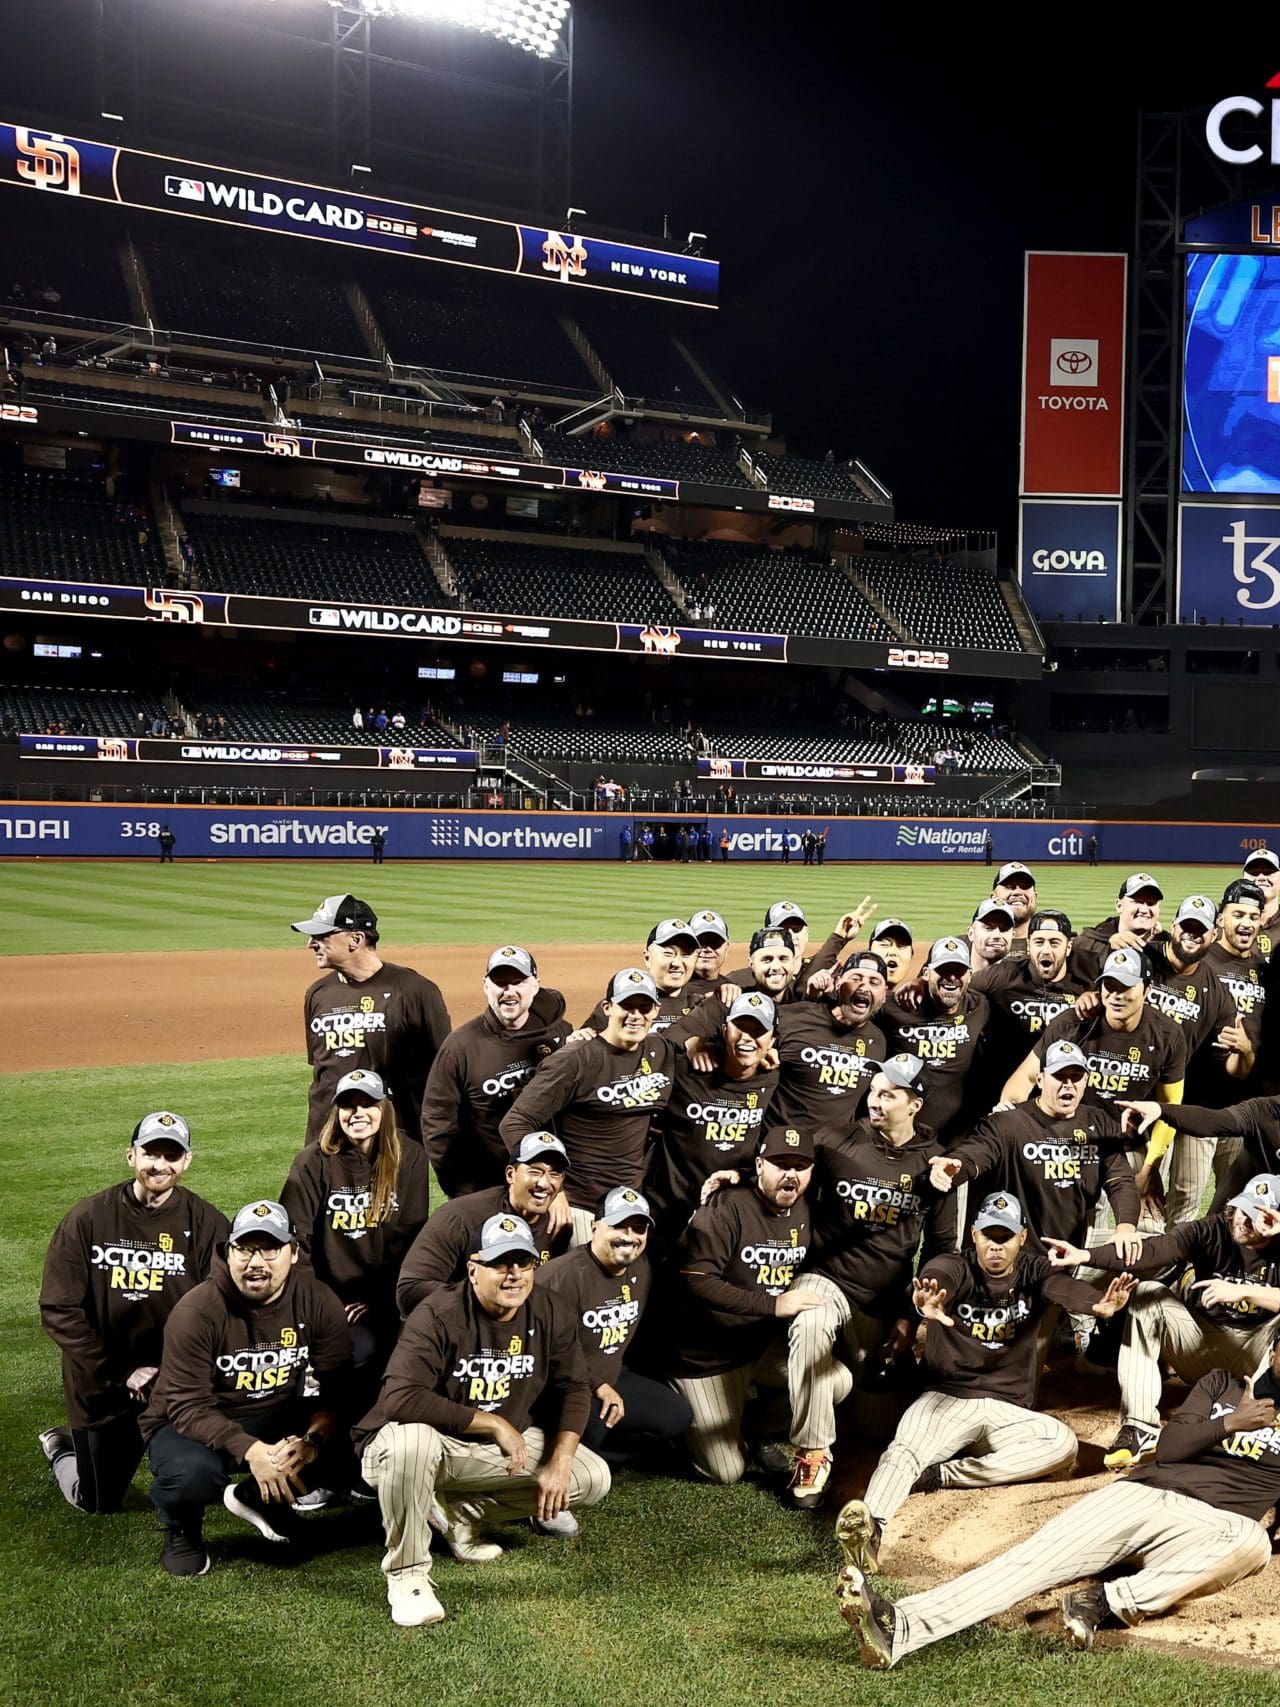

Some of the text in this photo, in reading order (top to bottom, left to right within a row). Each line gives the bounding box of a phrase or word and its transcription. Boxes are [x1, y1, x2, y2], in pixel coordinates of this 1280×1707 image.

[205, 181, 418, 237] WILD CARD 2022
[610, 261, 688, 285] NEW YORK
[1038, 395, 1109, 411] TOYOTA
[768, 494, 816, 514] 2022
[1032, 549, 1105, 572] GOYA
[20, 590, 110, 607] SAN DIEGO
[340, 608, 400, 630] WILD
[400, 614, 462, 635] CARD
[703, 639, 762, 652] NEW YORK
[887, 648, 950, 670] 2022
[775, 764, 804, 777] WILD
[803, 766, 836, 779] CARD
[120, 822, 161, 838] 358
[209, 819, 389, 846] smartwater
[463, 827, 593, 850] Northwell
[917, 828, 988, 846] National
[941, 845, 985, 855] Car Rental
[1047, 832, 1083, 857] citi
[1239, 838, 1267, 850] 408
[310, 1010, 387, 1037] OCTOBER
[898, 1021, 970, 1041] OCTOBER
[324, 1028, 367, 1051] RISE
[918, 1039, 957, 1058] RISE
[818, 1064, 860, 1089] RISE
[1087, 1072, 1130, 1093] RISE
[686, 1102, 764, 1126] OCTOBER
[704, 1122, 748, 1142] RISE
[1022, 1142, 1101, 1162] OCTOBER
[1044, 1159, 1083, 1181] RISE
[835, 1180, 922, 1213] OCTOBER
[853, 1202, 901, 1227] RISE
[91, 1245, 185, 1272] OCTOBER
[110, 1266, 166, 1292] RISE
[755, 1264, 794, 1286] RISE
[970, 1319, 1016, 1342] RISE
[215, 1345, 310, 1374] OCTOBER
[234, 1364, 294, 1392] RISE
[468, 1378, 512, 1402] RISE
